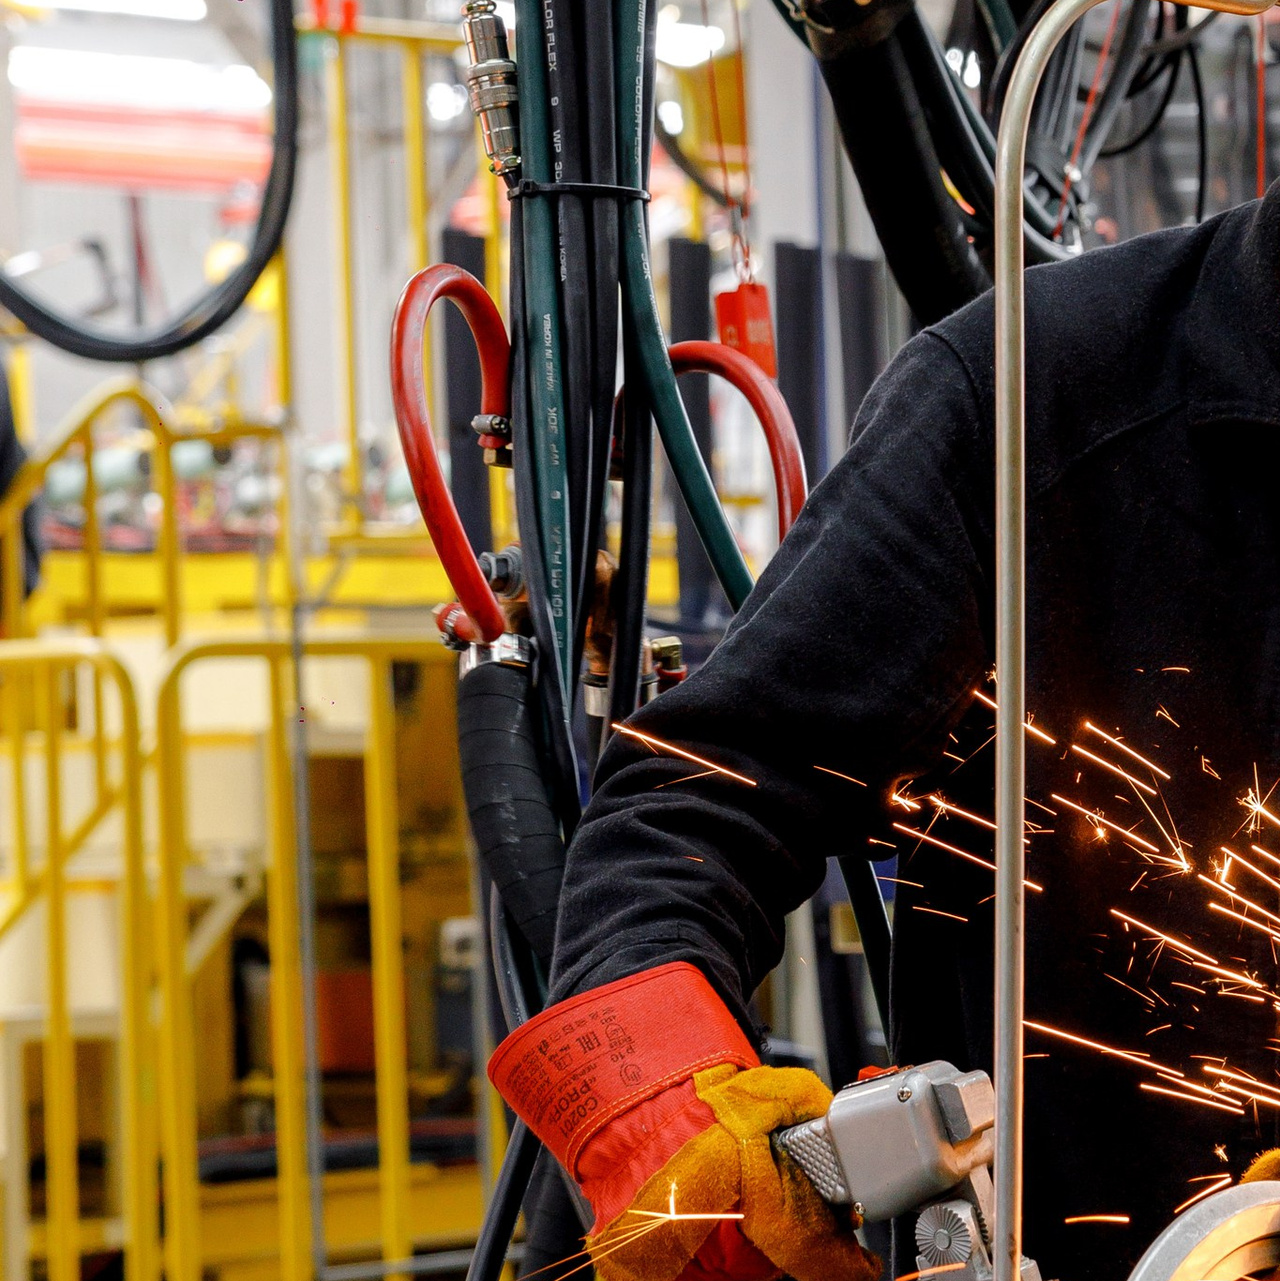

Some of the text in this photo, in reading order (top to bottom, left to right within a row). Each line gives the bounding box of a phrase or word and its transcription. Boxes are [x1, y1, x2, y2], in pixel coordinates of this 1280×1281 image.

[546, 32, 558, 72] FLEX
[552, 129, 562, 153] WP
[543, 313, 552, 346] KOREA
